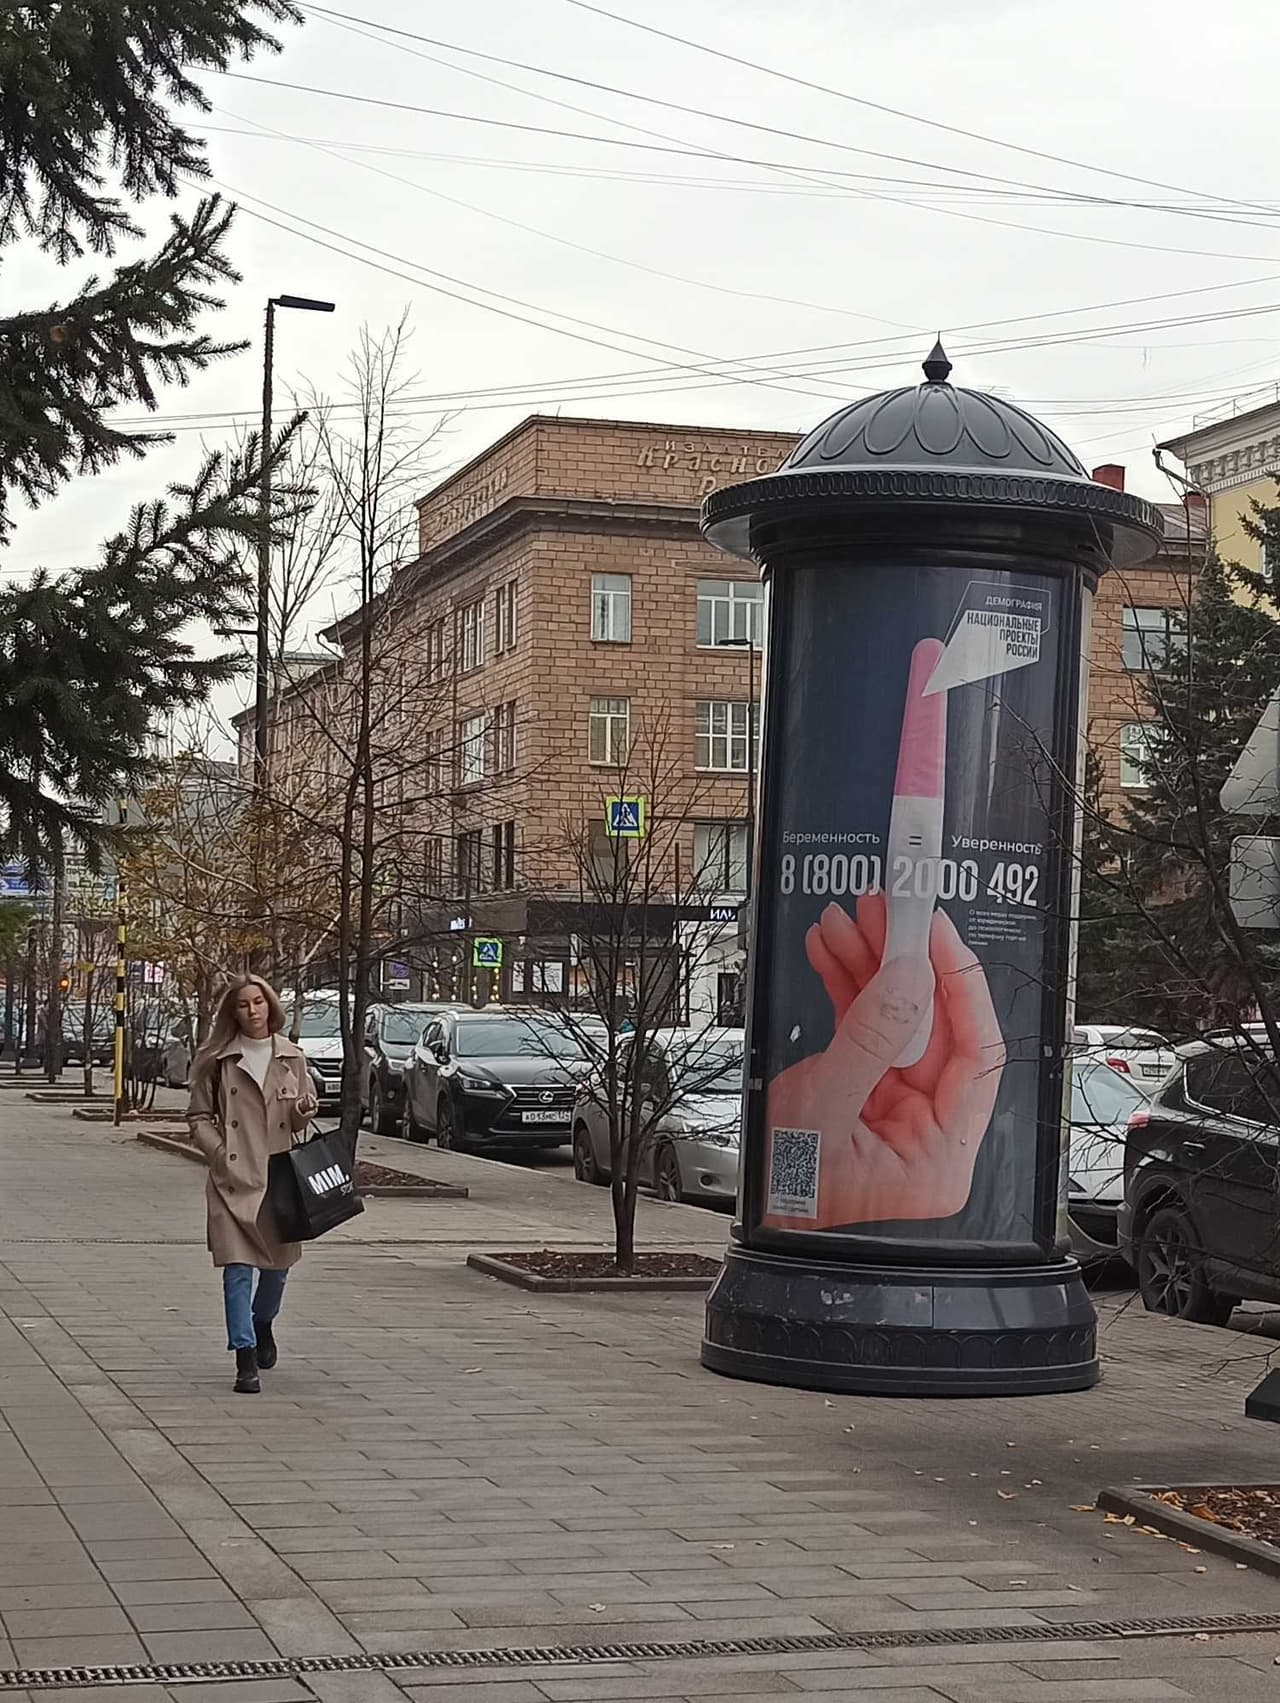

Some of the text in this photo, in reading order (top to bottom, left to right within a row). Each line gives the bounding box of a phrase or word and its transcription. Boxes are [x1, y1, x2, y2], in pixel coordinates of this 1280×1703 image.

[967, 611, 1039, 632] НАЦИОНАЛЬНЫЕ
[1000, 629, 1039, 645] ПРОЕКТЫ
[1006, 643, 1038, 658] РОССИИ
[782, 831, 880, 845] Беременность
[951, 835, 1042, 855] Уверенность
[781, 854, 1038, 907] 8 (800) 2000 492
